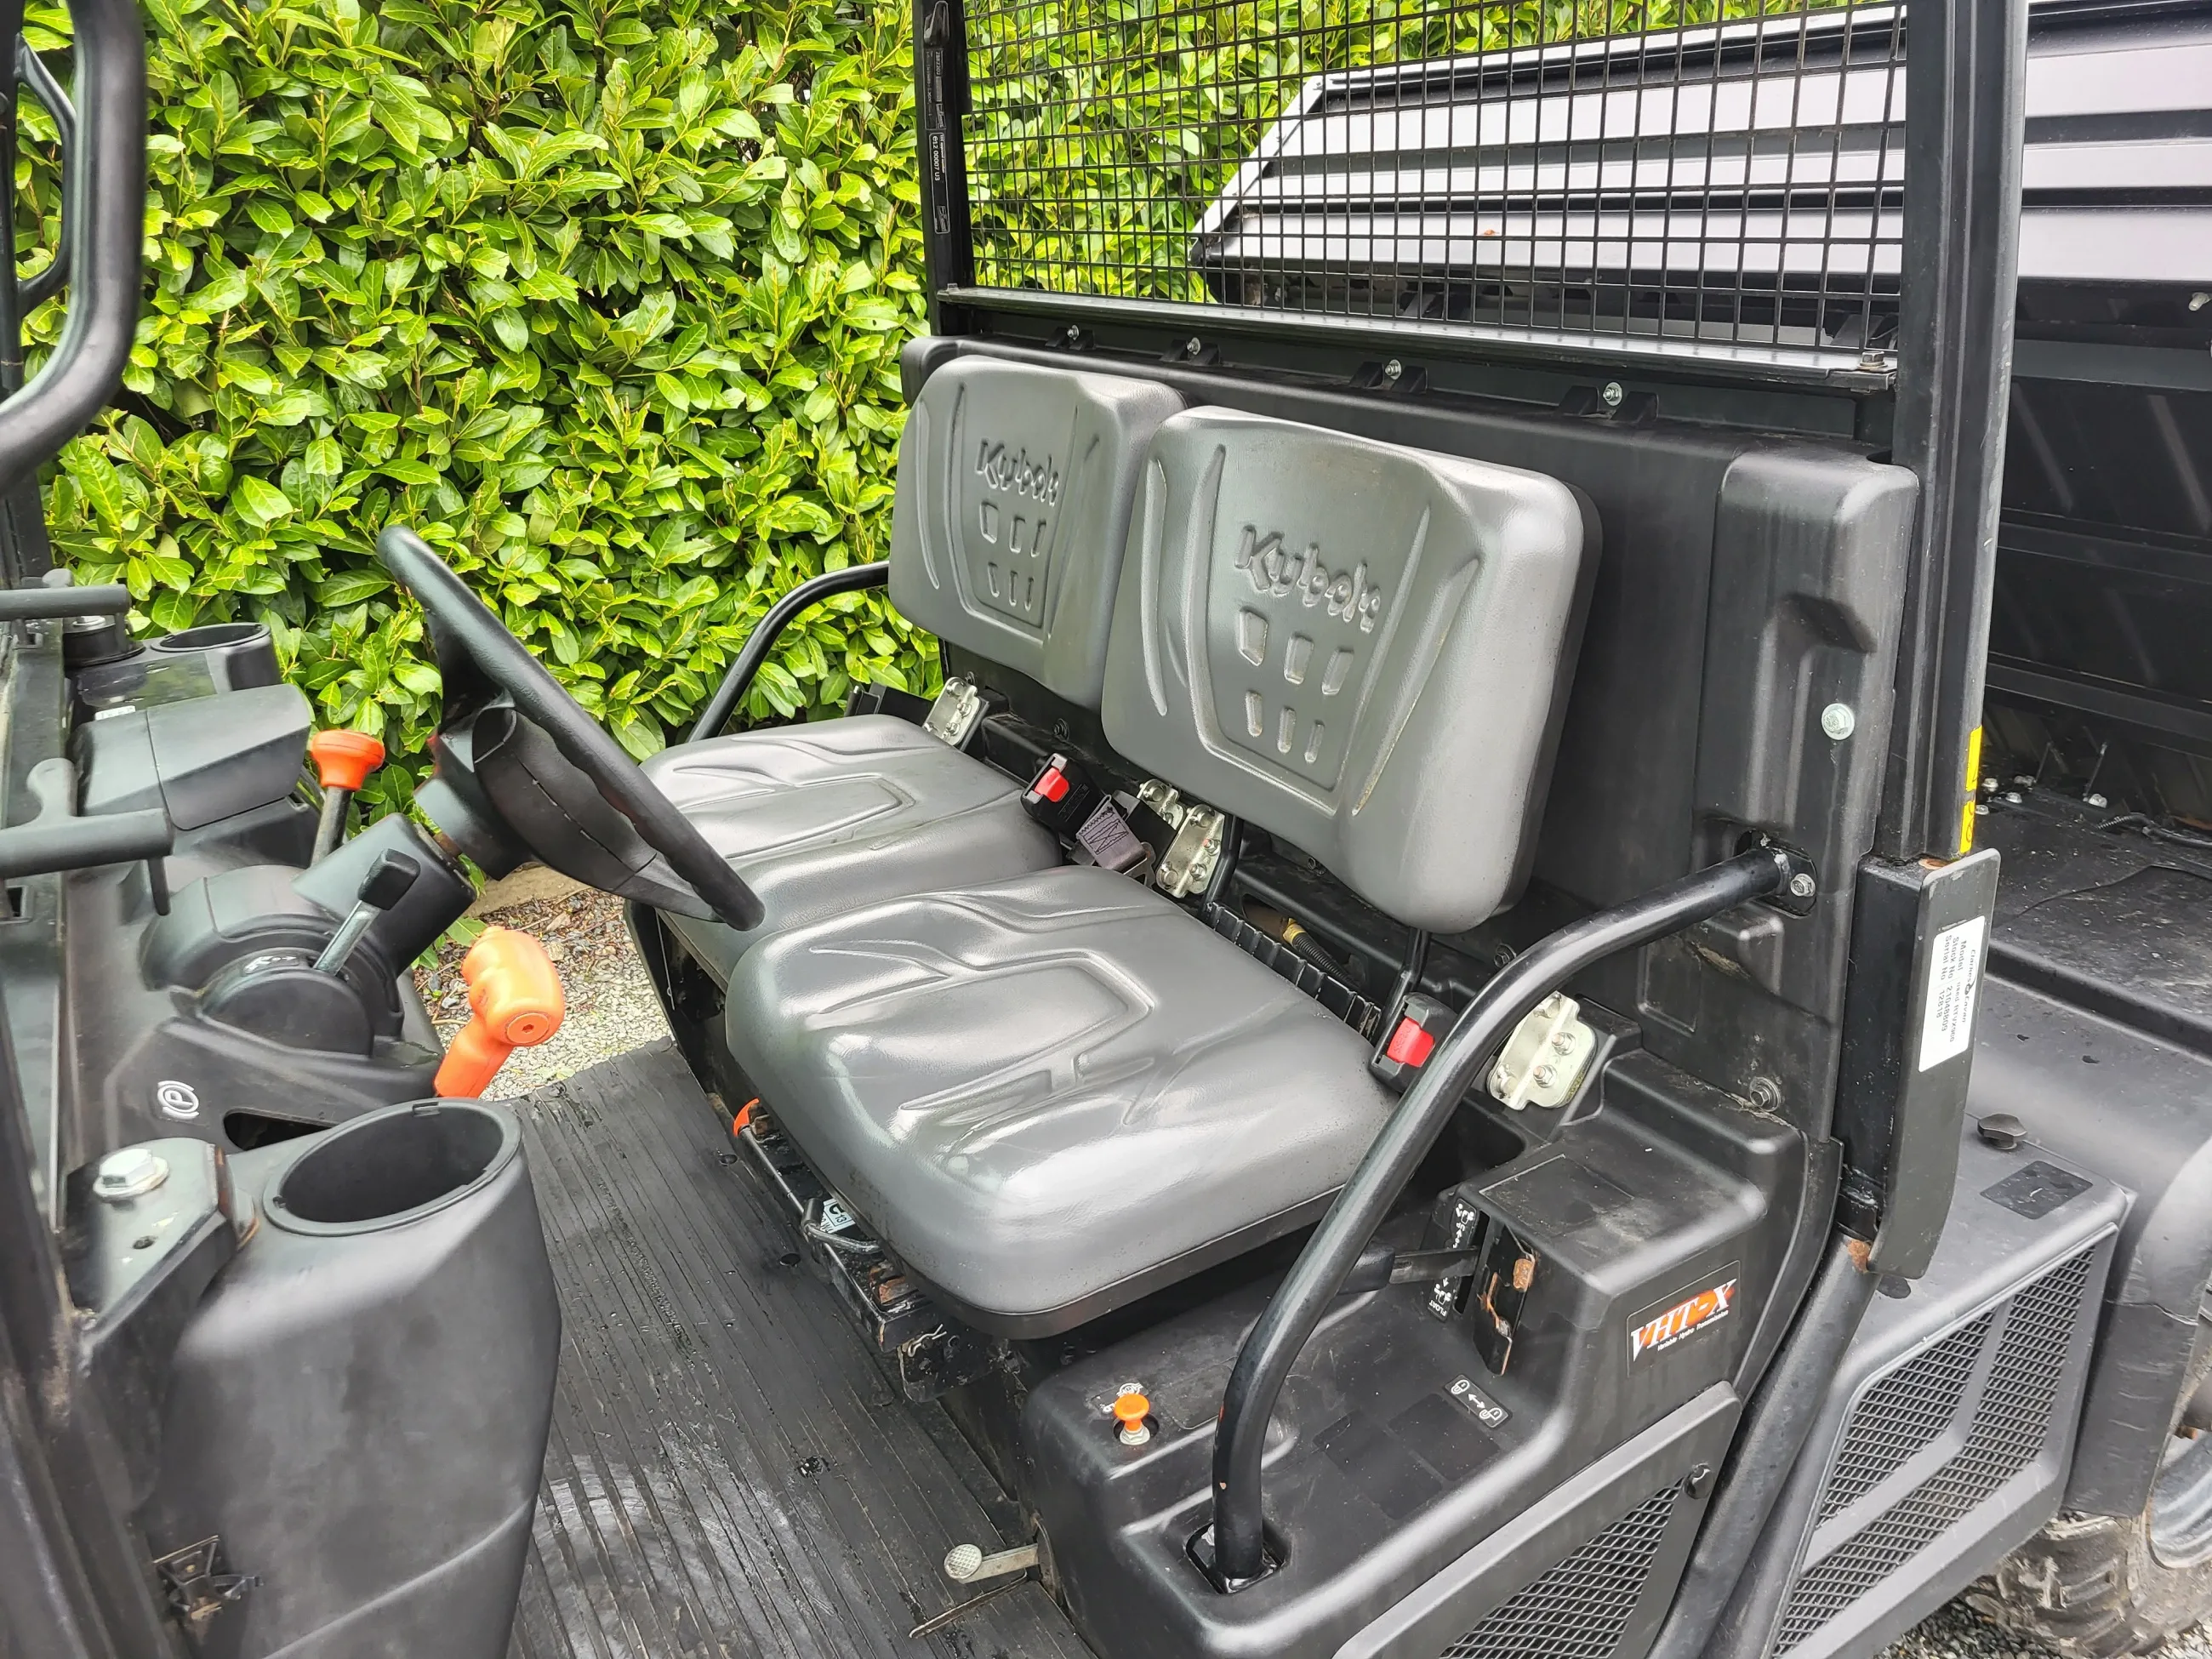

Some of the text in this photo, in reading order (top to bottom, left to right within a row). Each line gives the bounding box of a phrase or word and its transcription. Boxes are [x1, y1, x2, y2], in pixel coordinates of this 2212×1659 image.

[934, 172, 940, 181] U3
[975, 439, 1059, 507] Kubota
[1234, 524, 1381, 634] Kubota
[1942, 935, 1953, 964] Serial
[1949, 937, 1959, 963] Stock
[1958, 940, 1967, 971] Model
[1941, 966, 1948, 980] No
[1947, 966, 1956, 979] No
[835, 1214, 847, 1223] 13
[1456, 1222, 1466, 1232] UP
[1428, 1299, 1447, 1317] FLOAT
[1631, 1278, 1737, 1362] VHT-X
